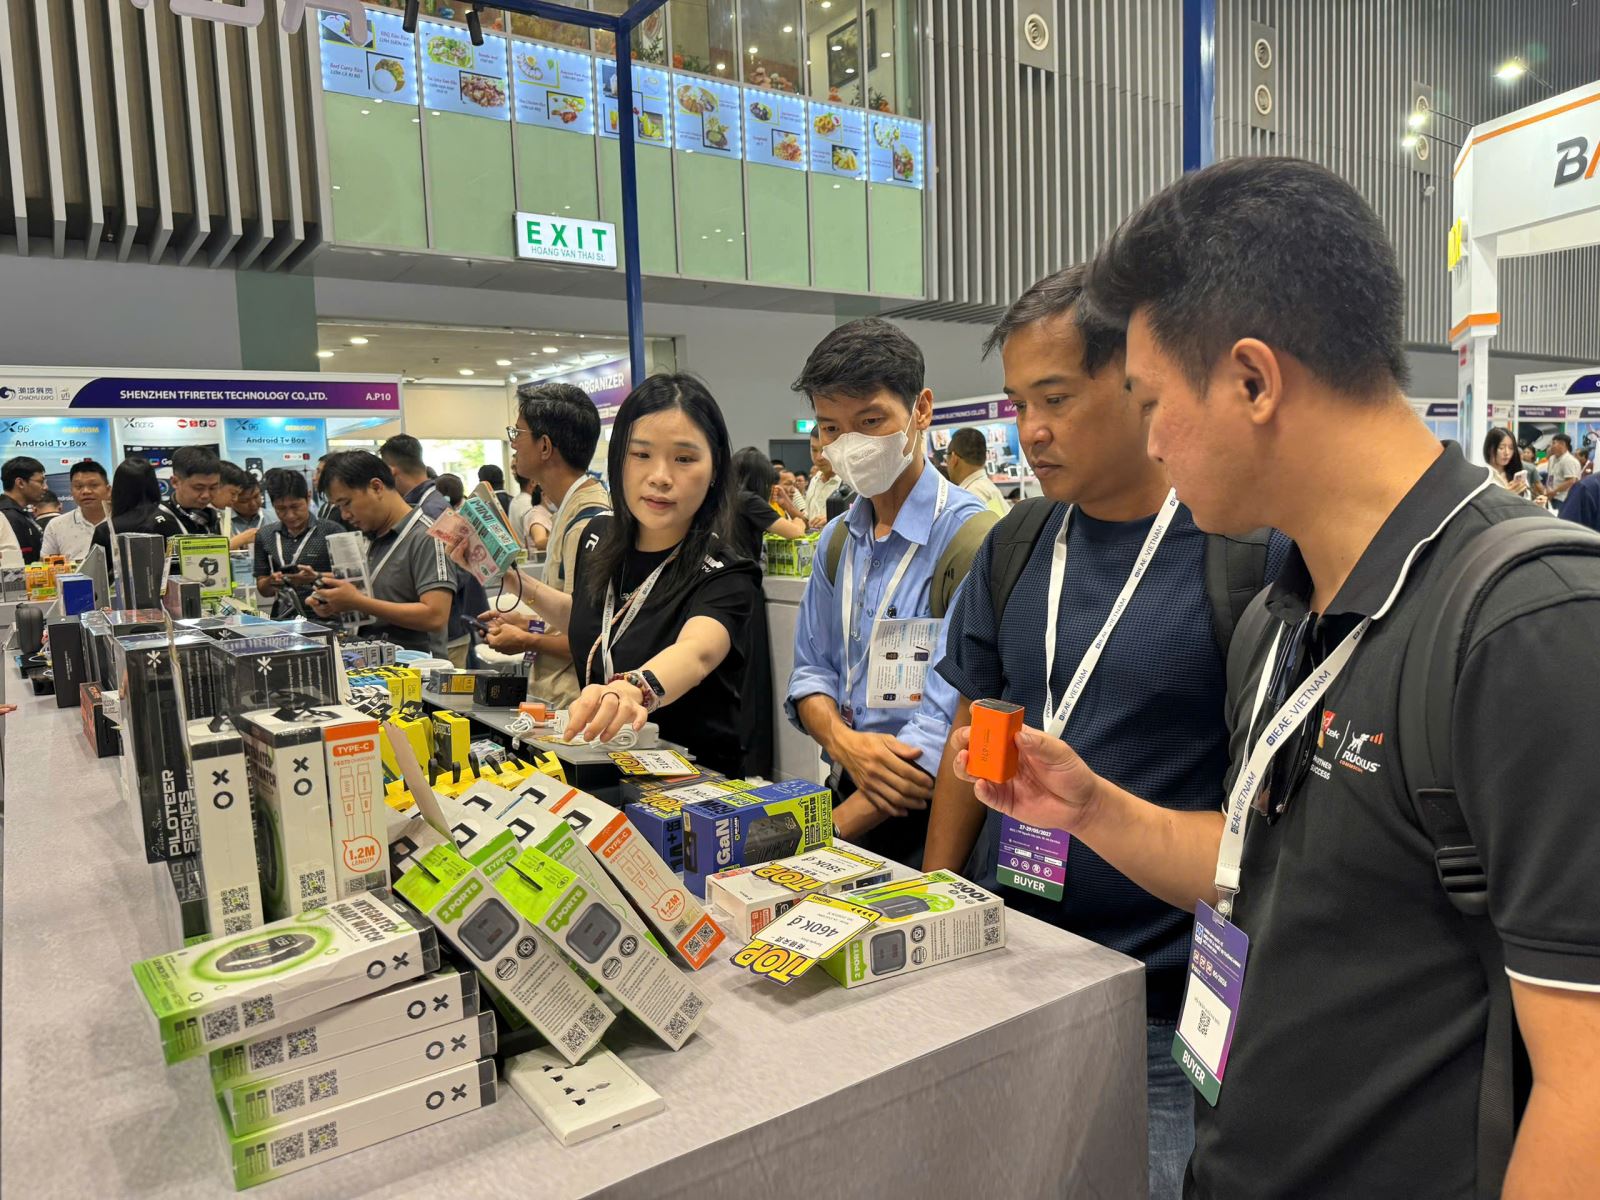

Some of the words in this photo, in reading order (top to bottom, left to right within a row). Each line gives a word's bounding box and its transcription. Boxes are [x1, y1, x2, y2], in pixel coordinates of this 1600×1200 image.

[526, 220, 607, 251] EXIT
[531, 246, 559, 257] HOANG
[561, 248, 577, 258] VAN
[577, 250, 595, 260] THAI
[120, 390, 177, 399] SHENZHEN
[178, 391, 224, 400] TFIRETEK
[224, 391, 289, 400] TECHNOLOGY
[291, 392, 328, 401] CO.,LTD.
[366, 393, 391, 401] A.P10
[577, 372, 625, 393] ORGANIZER
[1069, 668, 1088, 701] VIETNAM
[1290, 670, 1331, 716] VIETNAM
[336, 742, 370, 755] TYPE-C
[1341, 750, 1378, 773] RUCKUS
[608, 751, 650, 776] TOP
[1235, 771, 1257, 812] VIETNAM
[162, 769, 182, 857] PILOTEER
[178, 790, 196, 854] SERIES
[349, 846, 375, 861] 1.2M
[605, 831, 629, 854] TYPE-C
[715, 818, 731, 865] GaN
[351, 857, 375, 866] LENGTH
[814, 861, 846, 874] 380K
[752, 863, 827, 893] TOP
[1013, 874, 1045, 893] BUYER
[442, 910, 449, 919] 2
[448, 881, 479, 912] PORTS
[551, 919, 558, 928] 2
[557, 890, 583, 920] PORTS
[660, 894, 681, 916] 1.2M
[331, 903, 363, 922] SMART
[350, 918, 385, 943] WATCH
[350, 899, 398, 933] INTEGRATED
[801, 920, 839, 938] 460K
[730, 943, 808, 985] TOP
[853, 943, 861, 972] PORTS
[1182, 1050, 1206, 1085] BUYER
